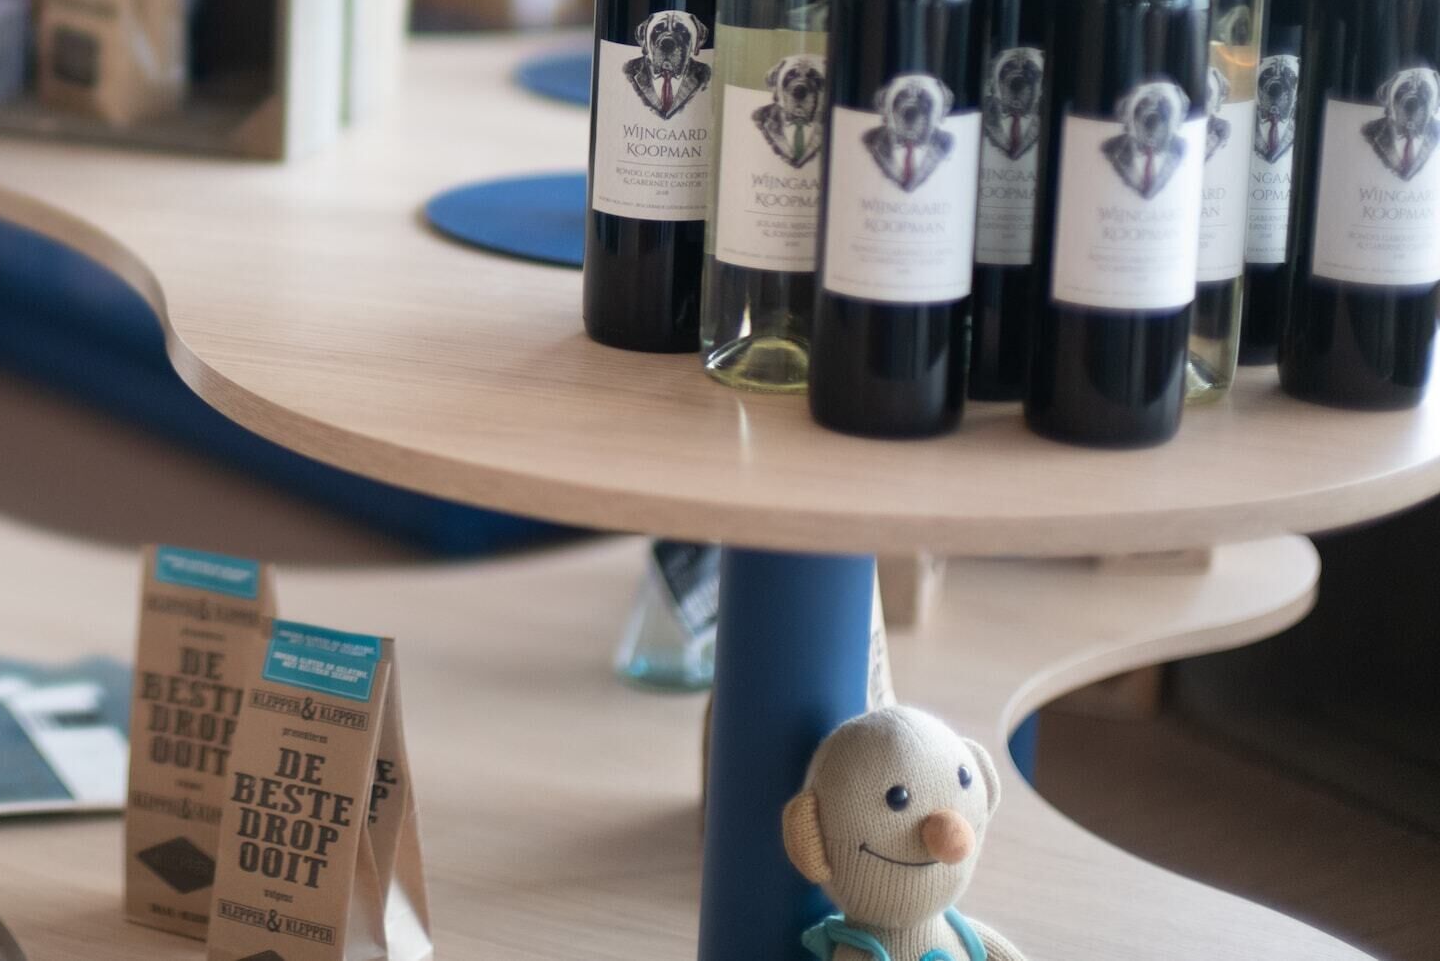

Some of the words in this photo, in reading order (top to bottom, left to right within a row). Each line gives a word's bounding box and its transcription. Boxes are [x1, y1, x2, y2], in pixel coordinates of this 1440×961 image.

[623, 124, 708, 140] WIJNGAARD
[627, 142, 702, 157] KOOPMAN
[751, 172, 820, 190] WIJNGAA
[1360, 187, 1433, 203] WIJNGAAR
[180, 647, 225, 680] DE
[148, 703, 238, 745] DROP
[253, 691, 301, 714] KLEPPER
[301, 697, 315, 720] &
[320, 707, 366, 729] KLEPPER
[150, 735, 232, 776] OOIT
[275, 747, 326, 785] DE
[231, 771, 354, 827] BESTE
[237, 806, 339, 856] DROP
[239, 841, 328, 889] OOIT
[221, 902, 266, 926] KLEPPER
[266, 909, 281, 933] &
[286, 917, 333, 943] KLEPPER
